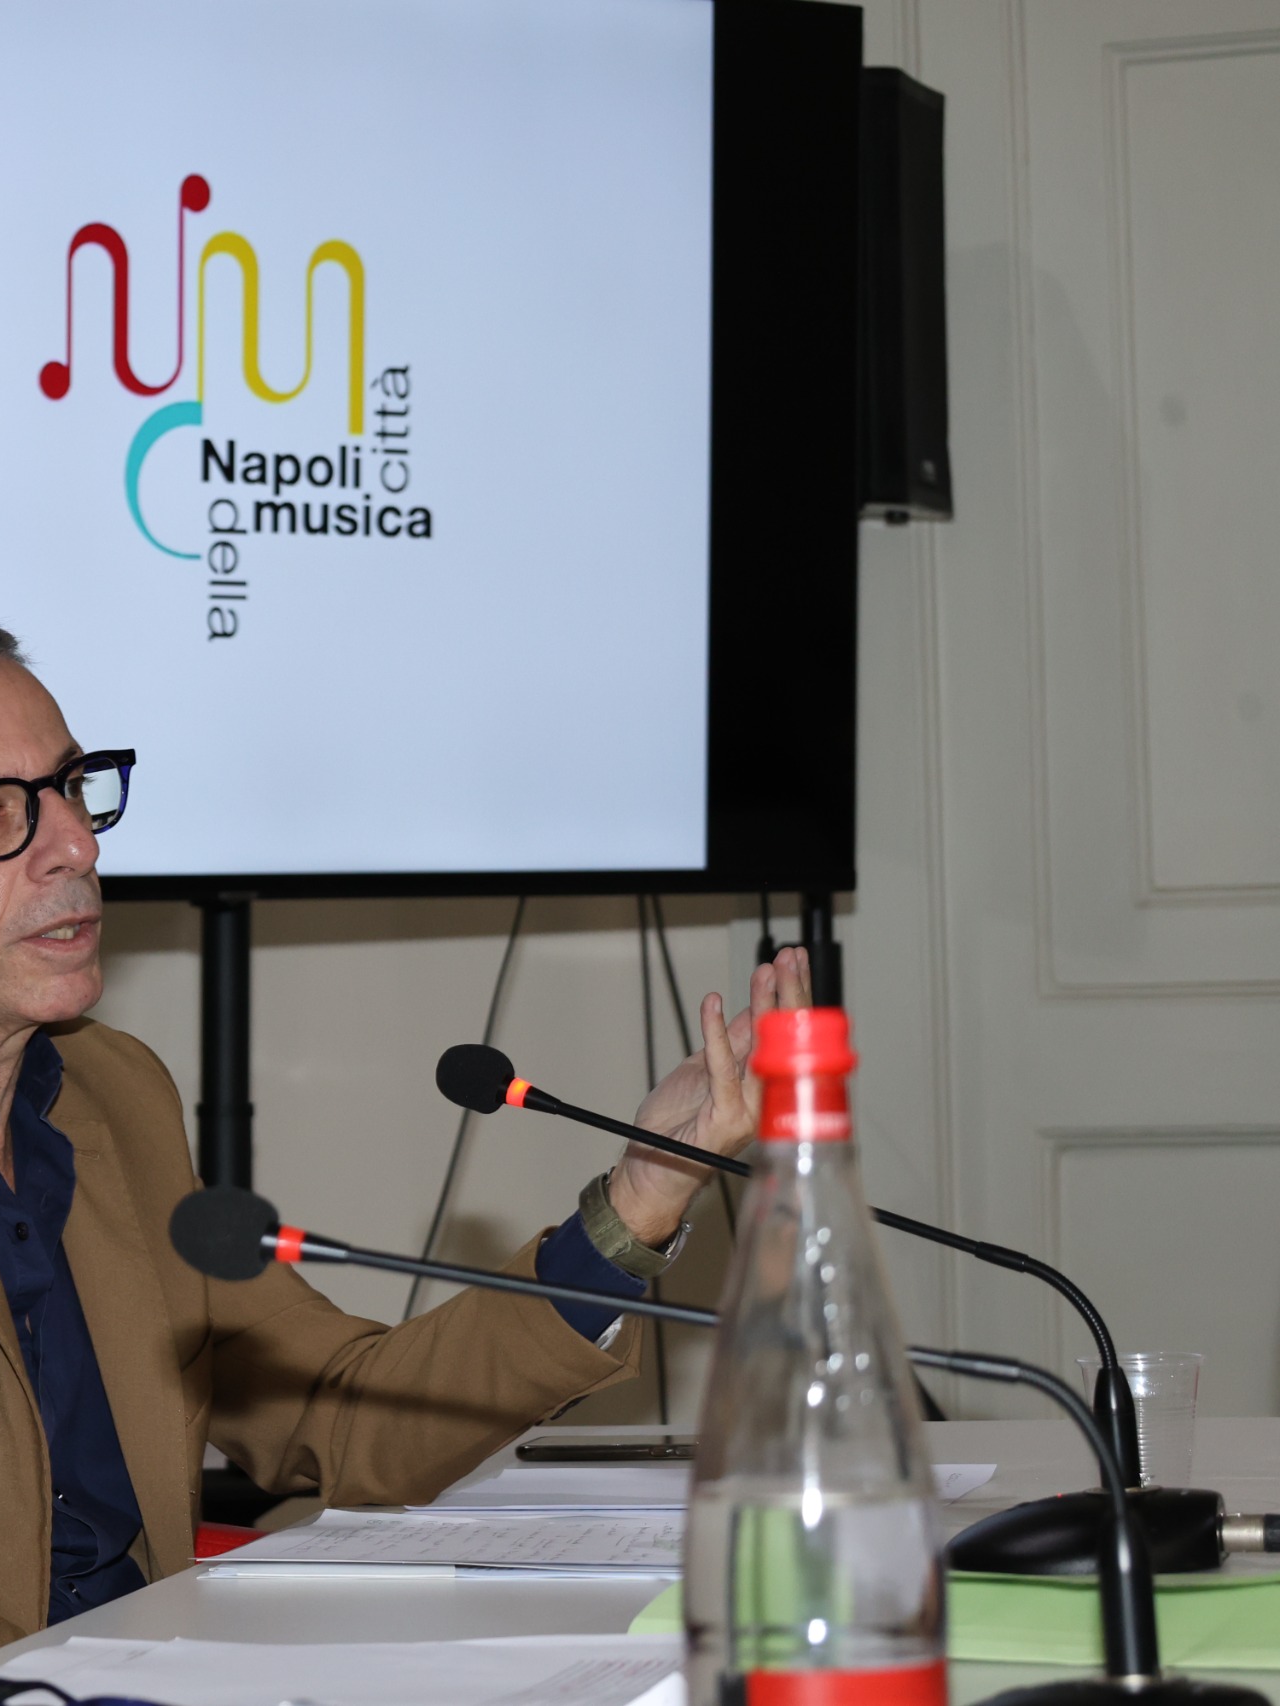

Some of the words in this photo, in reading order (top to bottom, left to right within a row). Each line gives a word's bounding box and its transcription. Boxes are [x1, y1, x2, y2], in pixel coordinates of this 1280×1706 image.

[200, 437, 363, 497] Napoli
[370, 363, 412, 495] città
[252, 494, 435, 540] musica
[207, 498, 248, 641] della
